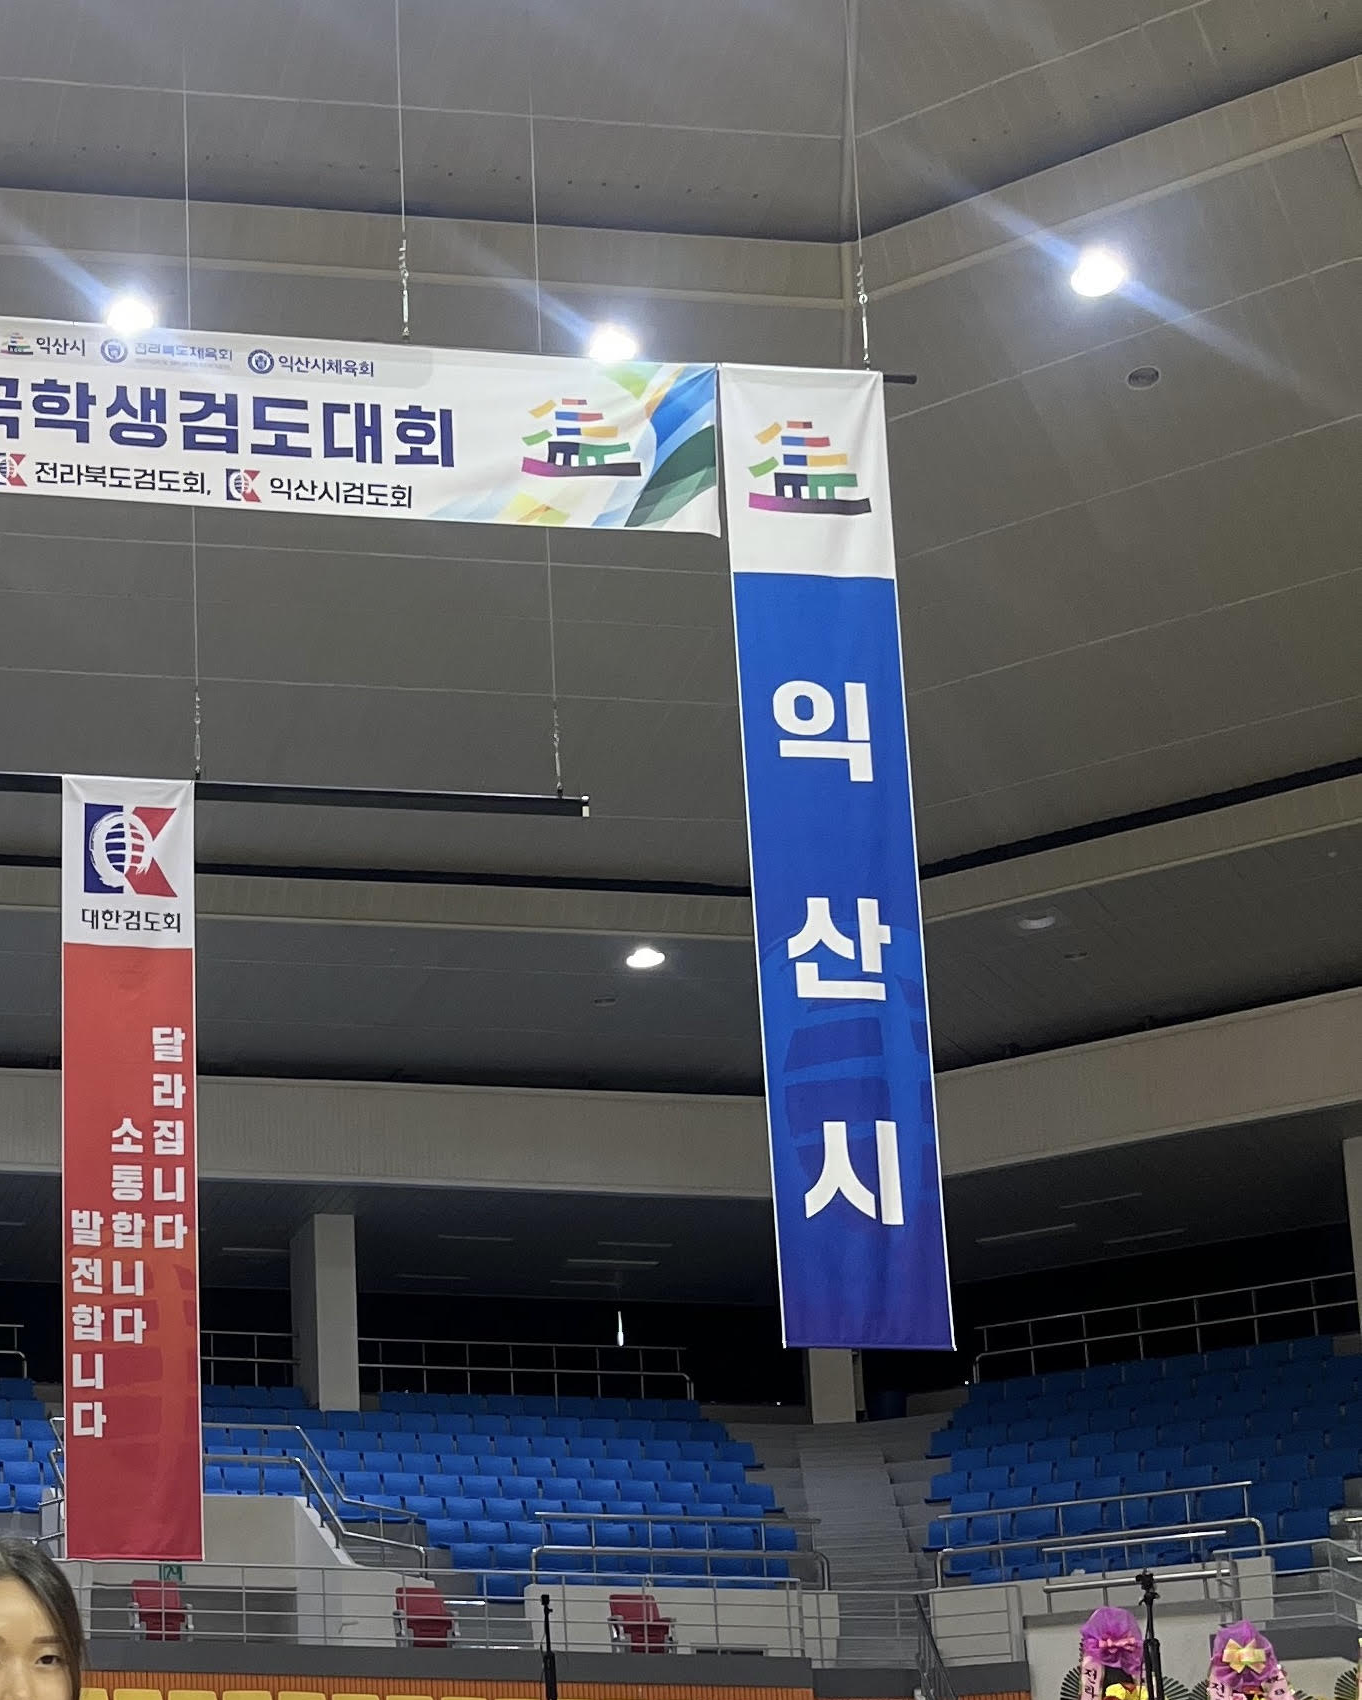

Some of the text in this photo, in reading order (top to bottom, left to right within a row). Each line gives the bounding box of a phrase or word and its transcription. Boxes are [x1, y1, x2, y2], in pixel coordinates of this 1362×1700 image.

[36, 335, 86, 358] 익산시
[278, 354, 375, 378] 익산시체육회
[35, 458, 212, 498] 전라북도검도회,
[269, 477, 413, 509] 익산시검도회
[81, 907, 182, 934] 대한검도회
[772, 680, 905, 1226] 익산시
[111, 1117, 147, 1344] 소통합니다
[152, 1026, 189, 1250] 달라집니다
[71, 1209, 107, 1439] 발전합니다
